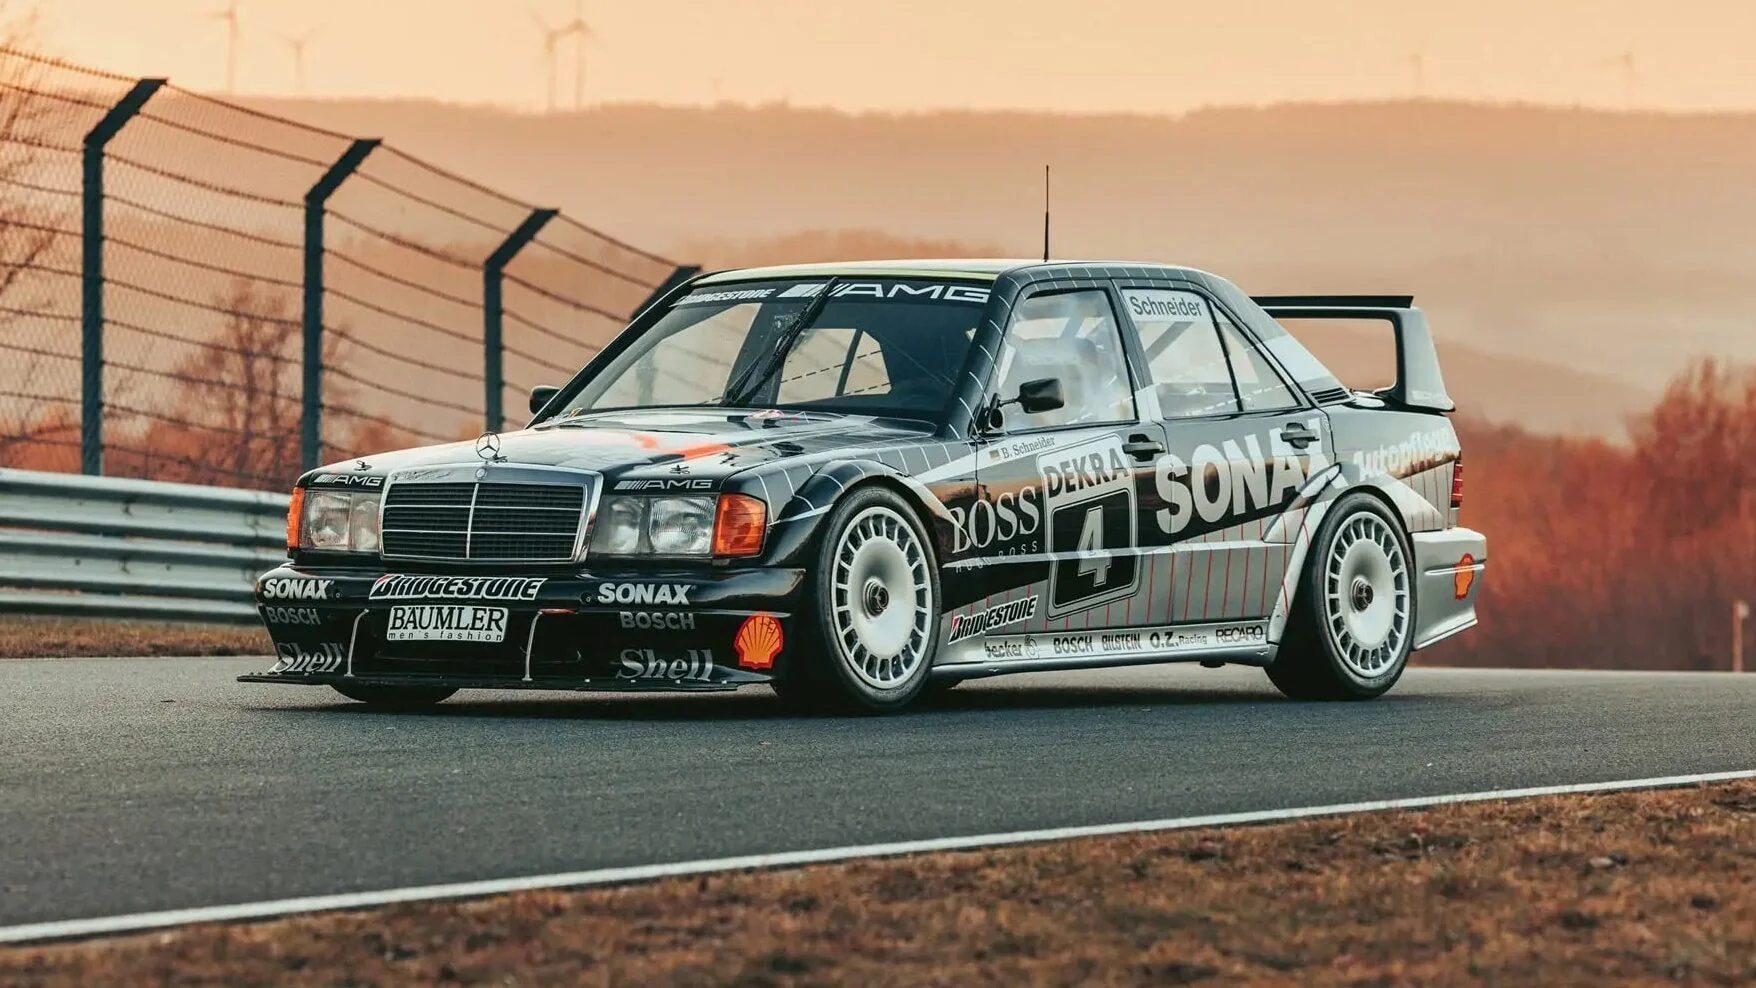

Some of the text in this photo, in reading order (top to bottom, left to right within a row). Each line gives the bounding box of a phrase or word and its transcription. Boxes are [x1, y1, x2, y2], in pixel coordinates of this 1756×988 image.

[837, 283, 992, 303] AMG
[1130, 296, 1203, 317] Schneider
[1001, 436, 1056, 459] B. Schneider
[332, 474, 383, 487] AMG
[1043, 447, 1130, 498] DEKRA
[641, 479, 713, 490] AMG
[949, 486, 1040, 554] BOSS
[1076, 505, 1112, 588] 4
[263, 579, 331, 600] SONAX
[369, 574, 547, 601] BRIDGESTONE
[597, 583, 691, 605] SONAX
[267, 606, 321, 625] BOSCH
[390, 606, 505, 632] BÄUMLER
[619, 611, 696, 630] BOSCH
[388, 631, 503, 641] men's fashion
[1053, 635, 1094, 654] BOSCH
[1101, 633, 1142, 651] BILSTEIN
[1215, 625, 1264, 643] RECARO
[270, 643, 344, 674] Shell
[984, 640, 1022, 657] becker
[615, 649, 714, 682] Shell
